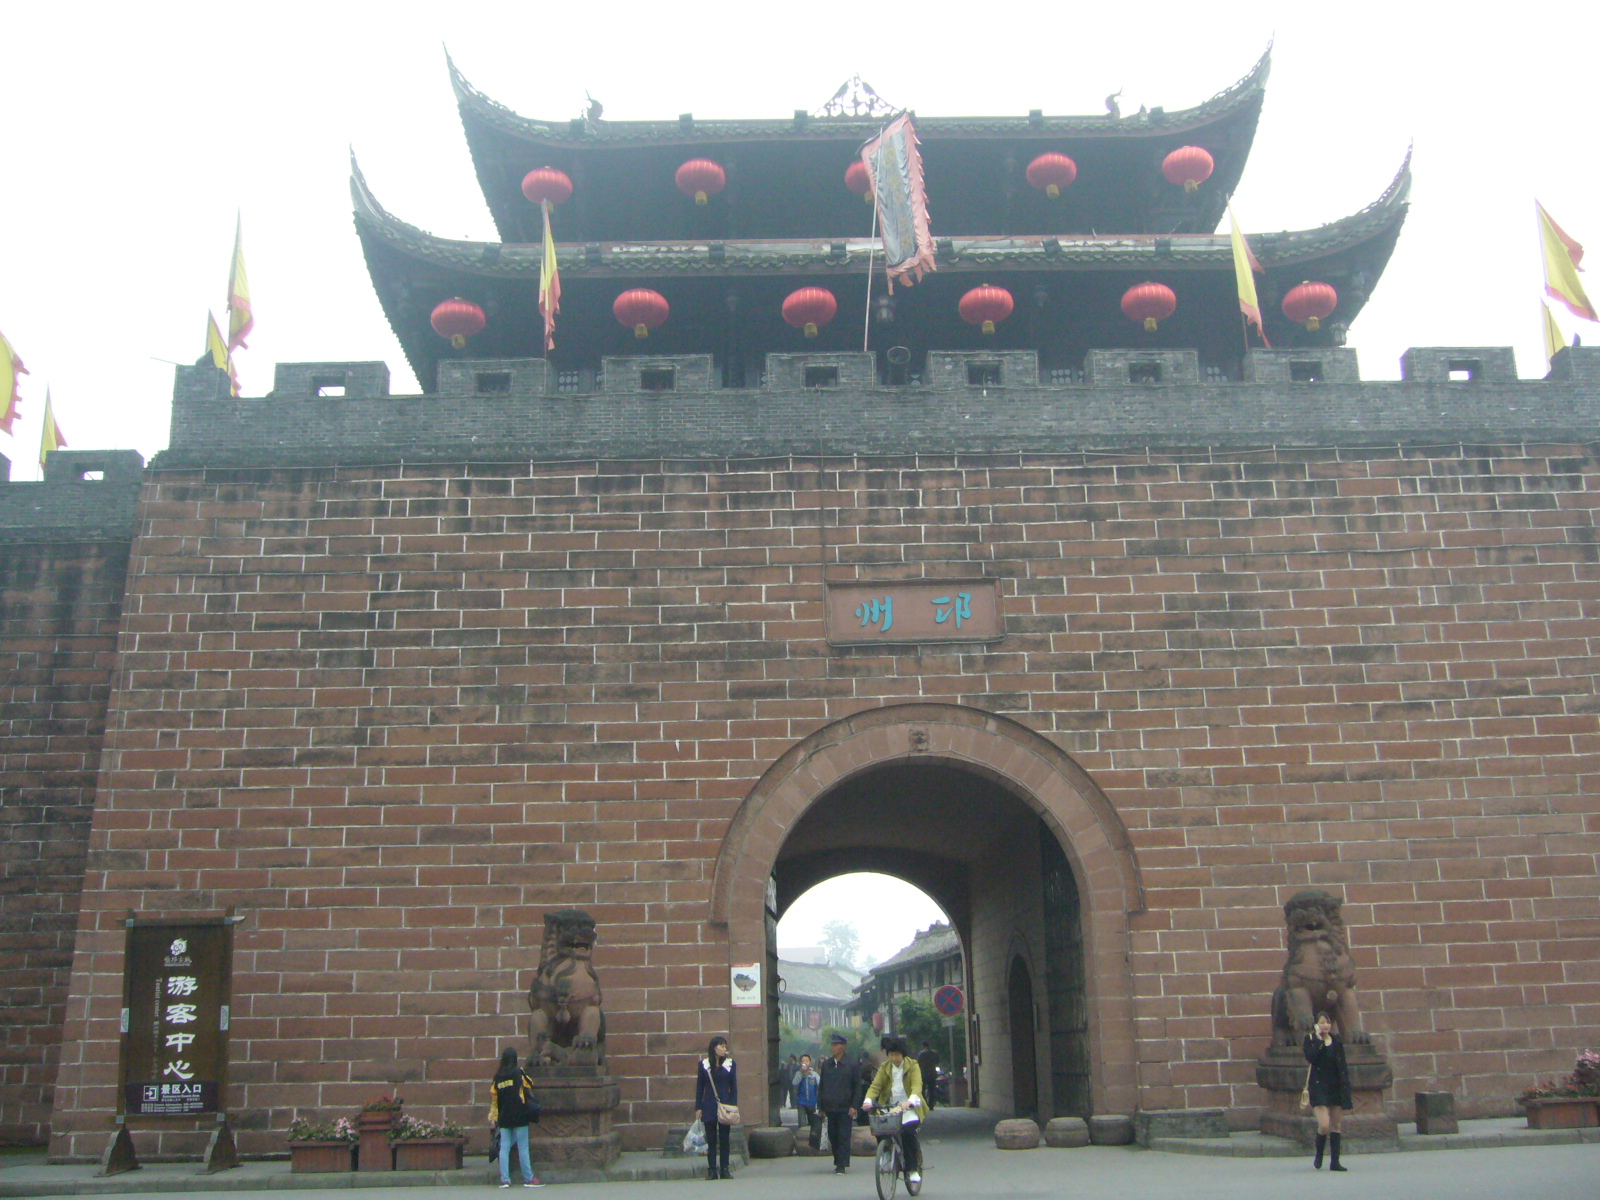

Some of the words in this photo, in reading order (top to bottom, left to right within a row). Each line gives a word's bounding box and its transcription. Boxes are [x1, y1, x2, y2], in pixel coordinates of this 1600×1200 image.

[164, 975, 198, 1080] 游客中心
[161, 1084, 202, 1095] 景区入口
